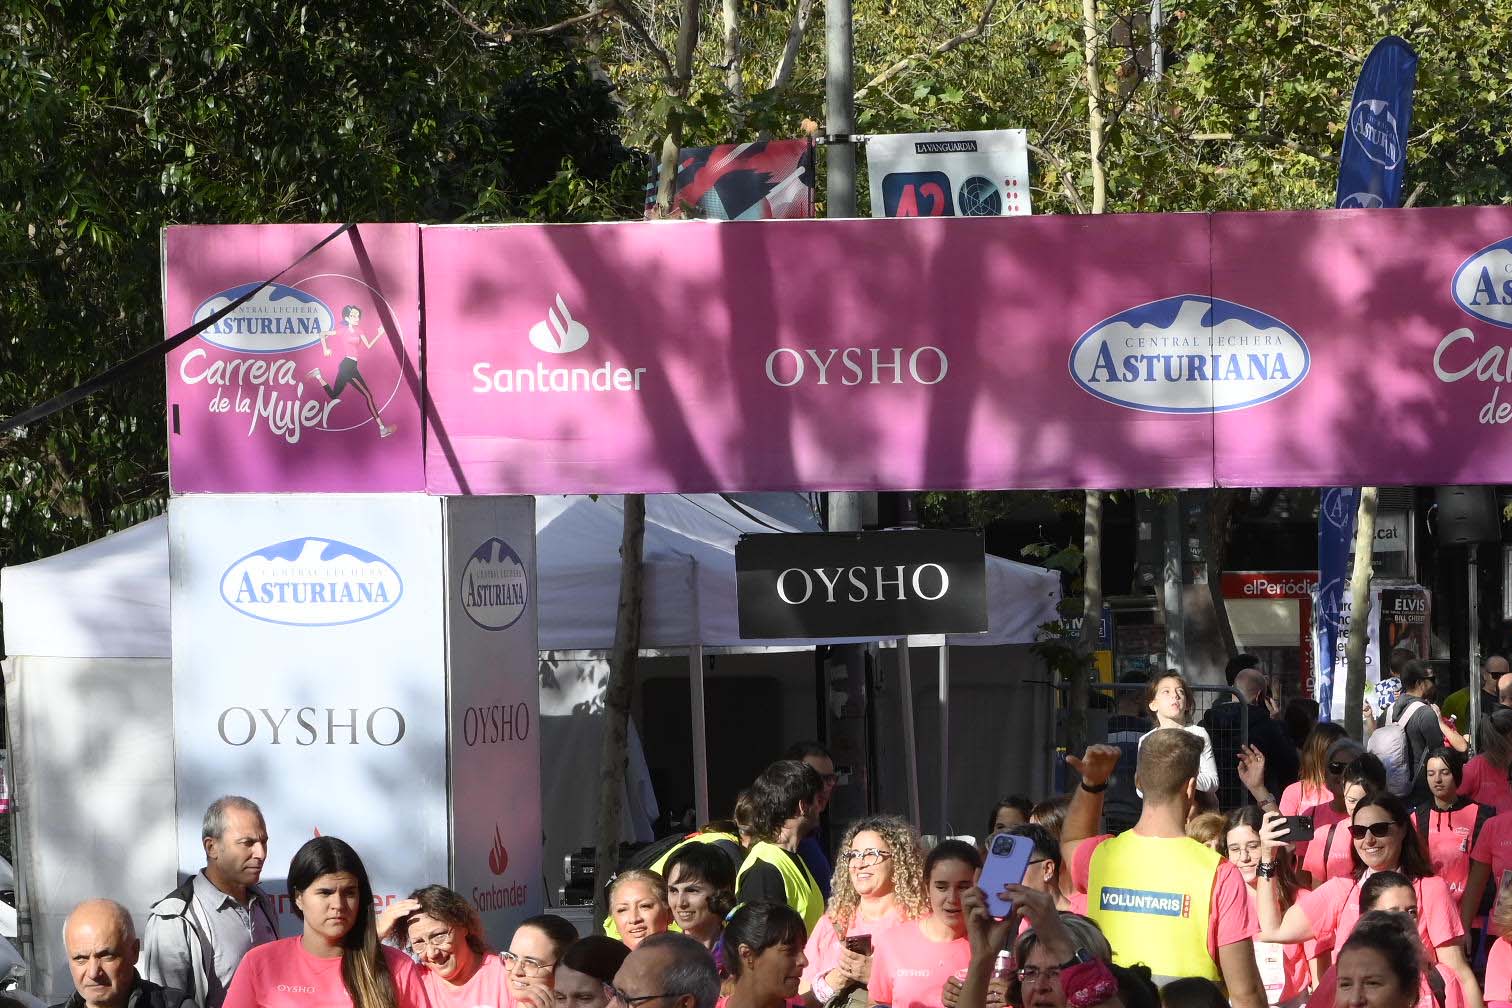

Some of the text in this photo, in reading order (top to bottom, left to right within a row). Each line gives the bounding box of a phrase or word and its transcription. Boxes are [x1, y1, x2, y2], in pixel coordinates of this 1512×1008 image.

[203, 308, 322, 335] ASTURIANA
[1125, 335, 1283, 348] CENTRAL LECHERA
[180, 349, 297, 385] Carrera
[473, 361, 646, 392] Santander
[765, 346, 949, 387] OYSHO
[1088, 340, 1291, 383] ASTURIANA
[209, 382, 341, 444] de la Mujer
[235, 571, 391, 603] ASTURIANA
[466, 574, 525, 608] ASTURIANA
[776, 563, 950, 605] OYSHO
[1395, 599, 1425, 611] ELVIS
[217, 706, 406, 746] OYSHO
[463, 702, 529, 747] OYSHO
[473, 882, 527, 914] Santander
[1102, 891, 1181, 912] VOLUNTARIS
[277, 983, 315, 994] OYSHO
